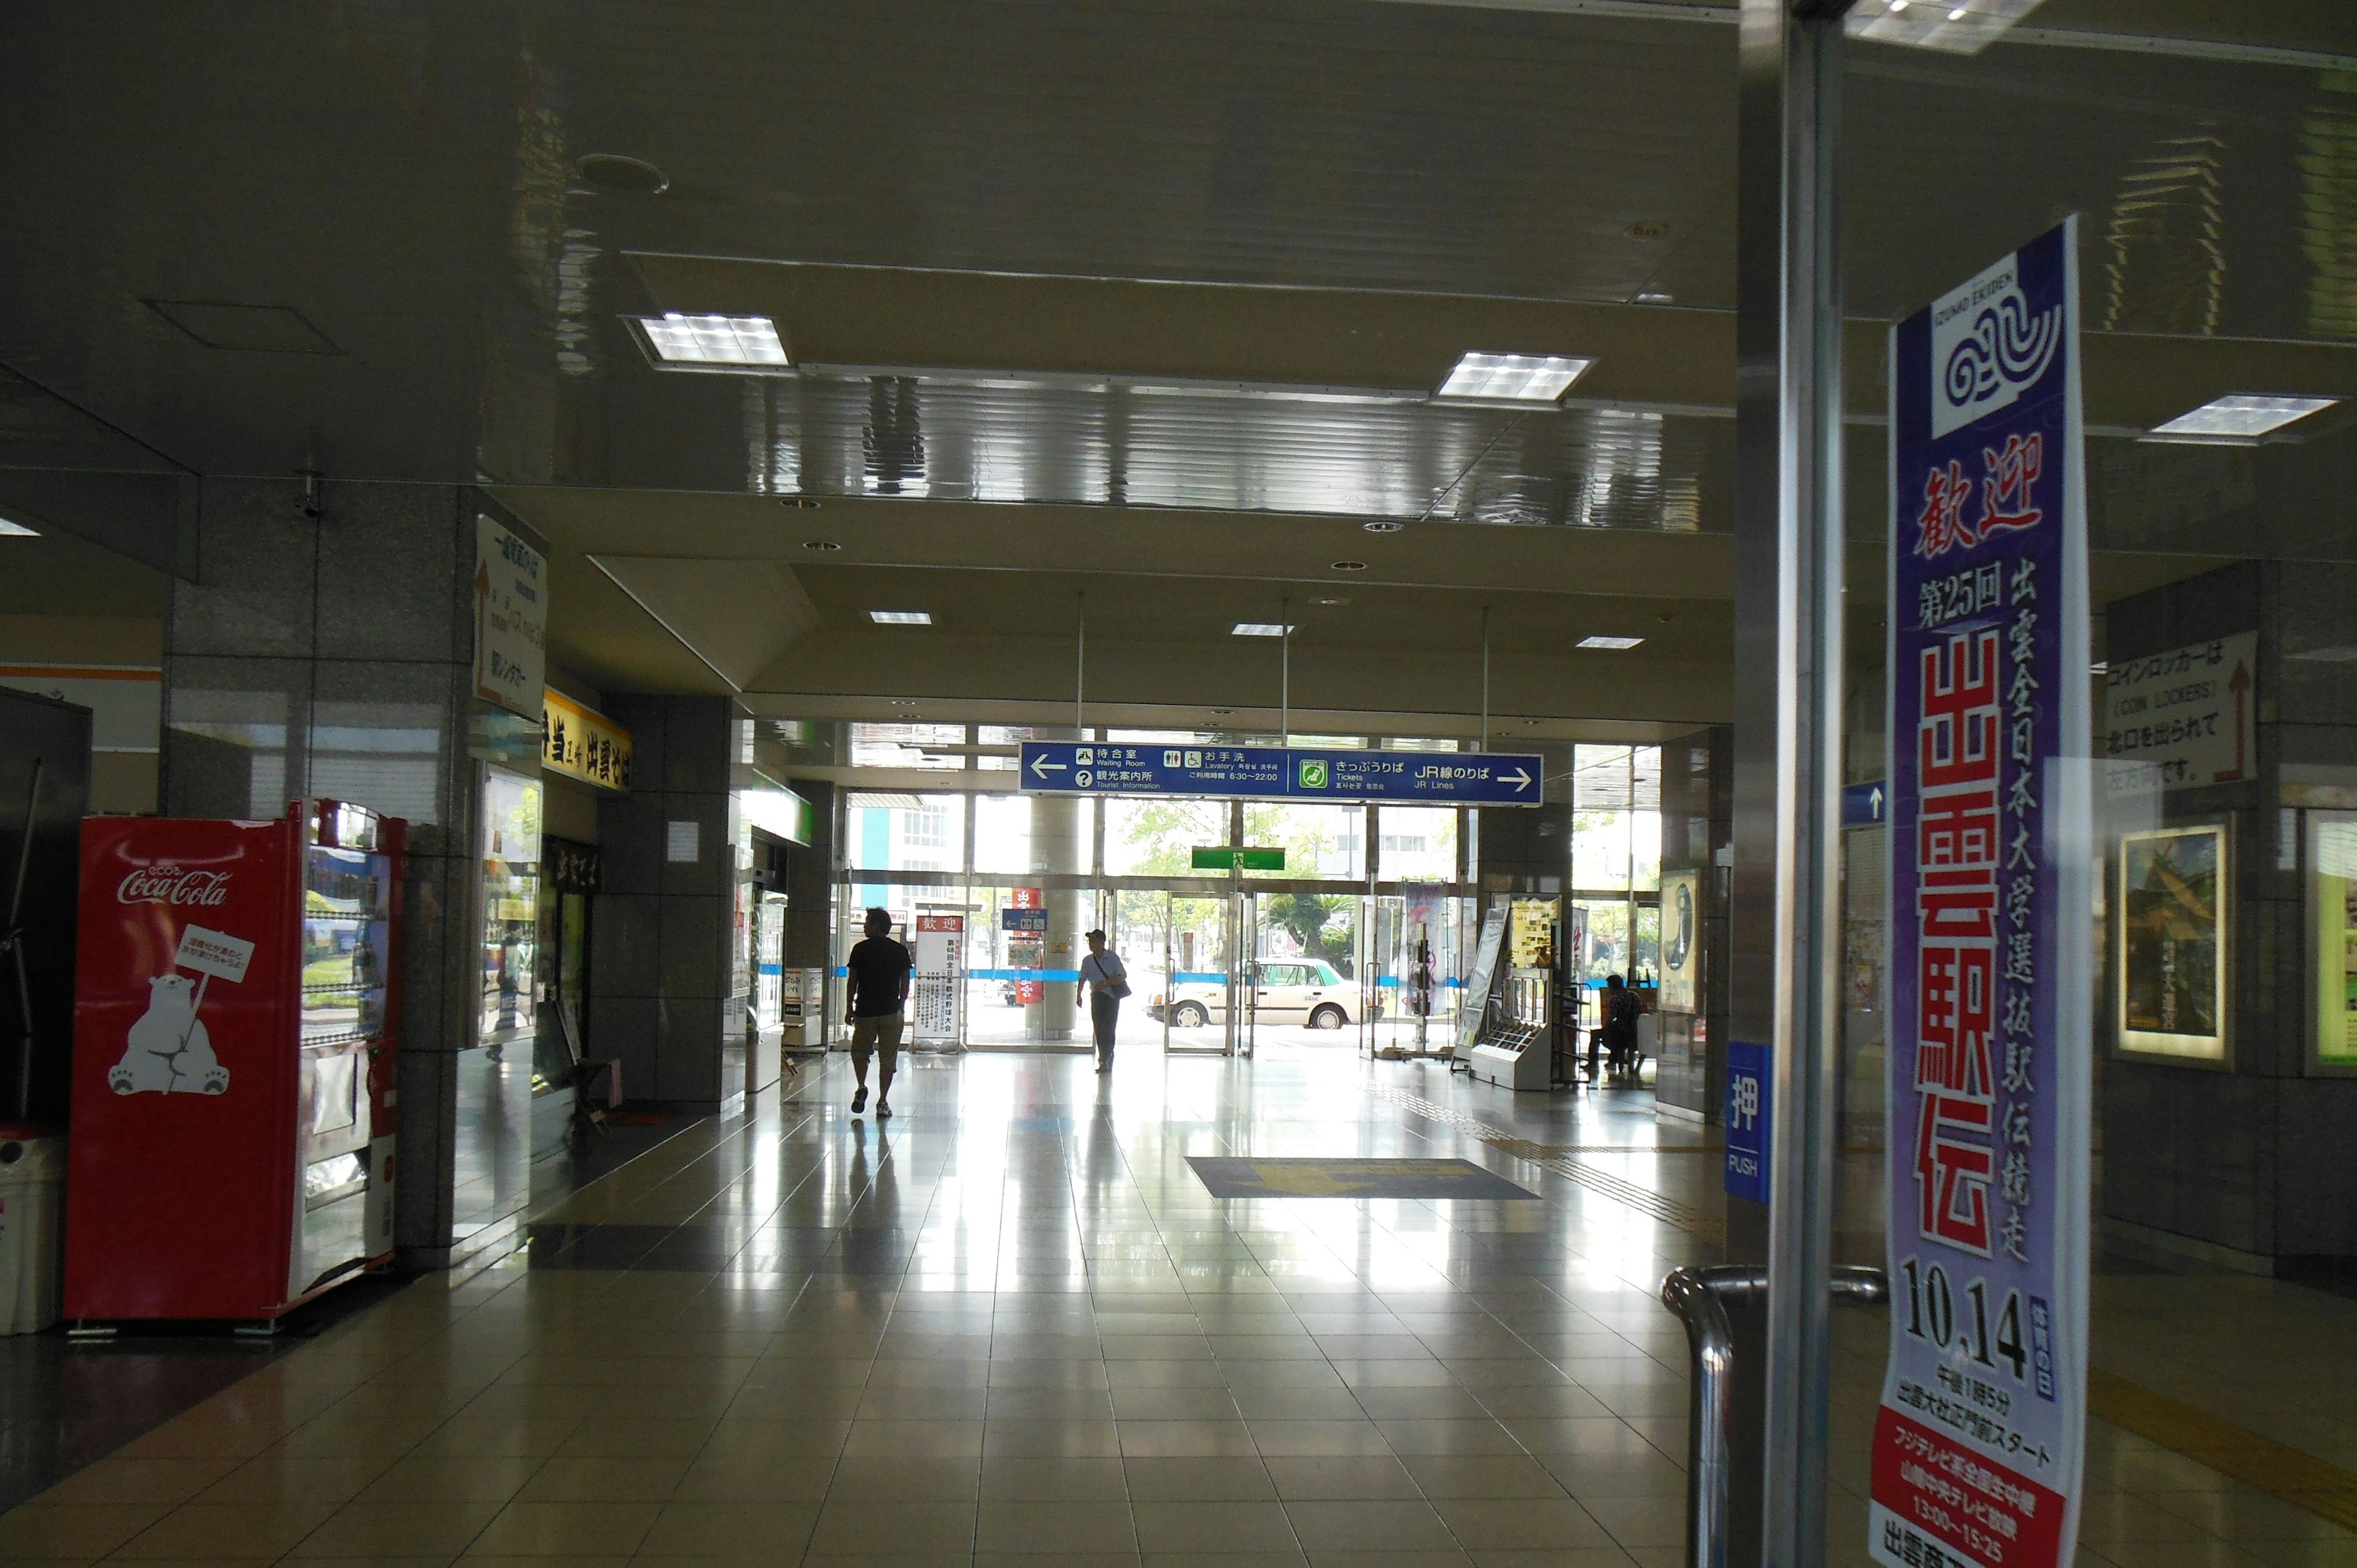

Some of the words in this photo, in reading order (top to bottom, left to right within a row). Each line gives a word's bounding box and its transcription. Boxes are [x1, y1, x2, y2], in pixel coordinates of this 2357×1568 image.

[1935, 296, 1970, 328] IZUMO
[1972, 270, 2014, 306] EKIDEN
[1913, 432, 2043, 558] 歓迎
[1919, 560, 2002, 628] 第25回
[2106, 640, 2223, 687] コインロッカーは
[2107, 712, 2219, 755] 北口を出られて
[1097, 748, 1138, 760] 待合室
[1097, 760, 1122, 768] Waiting
[1205, 752, 1245, 763] お手洗
[1205, 763, 1234, 771] Lavatory
[1336, 761, 1404, 773] きっぷうりば
[1096, 771, 1153, 782] 観光案内所
[1190, 771, 1225, 781] ご利用時間
[1414, 765, 1490, 780] JR線のりば
[1431, 781, 1454, 790] Lines
[117, 869, 234, 906] Coca-Cola
[923, 917, 956, 931] 歓迎
[2001, 557, 2040, 1264] 出雲全日本大学選抜駅伝競走
[1914, 628, 2001, 1261] 出雲駅伝
[944, 939, 954, 1033] 第68回全日本軟式野球大会
[1732, 1073, 1759, 1131] 押
[1728, 1154, 1759, 1178] PUSH
[1884, 1518, 1967, 1568] 出雲商
